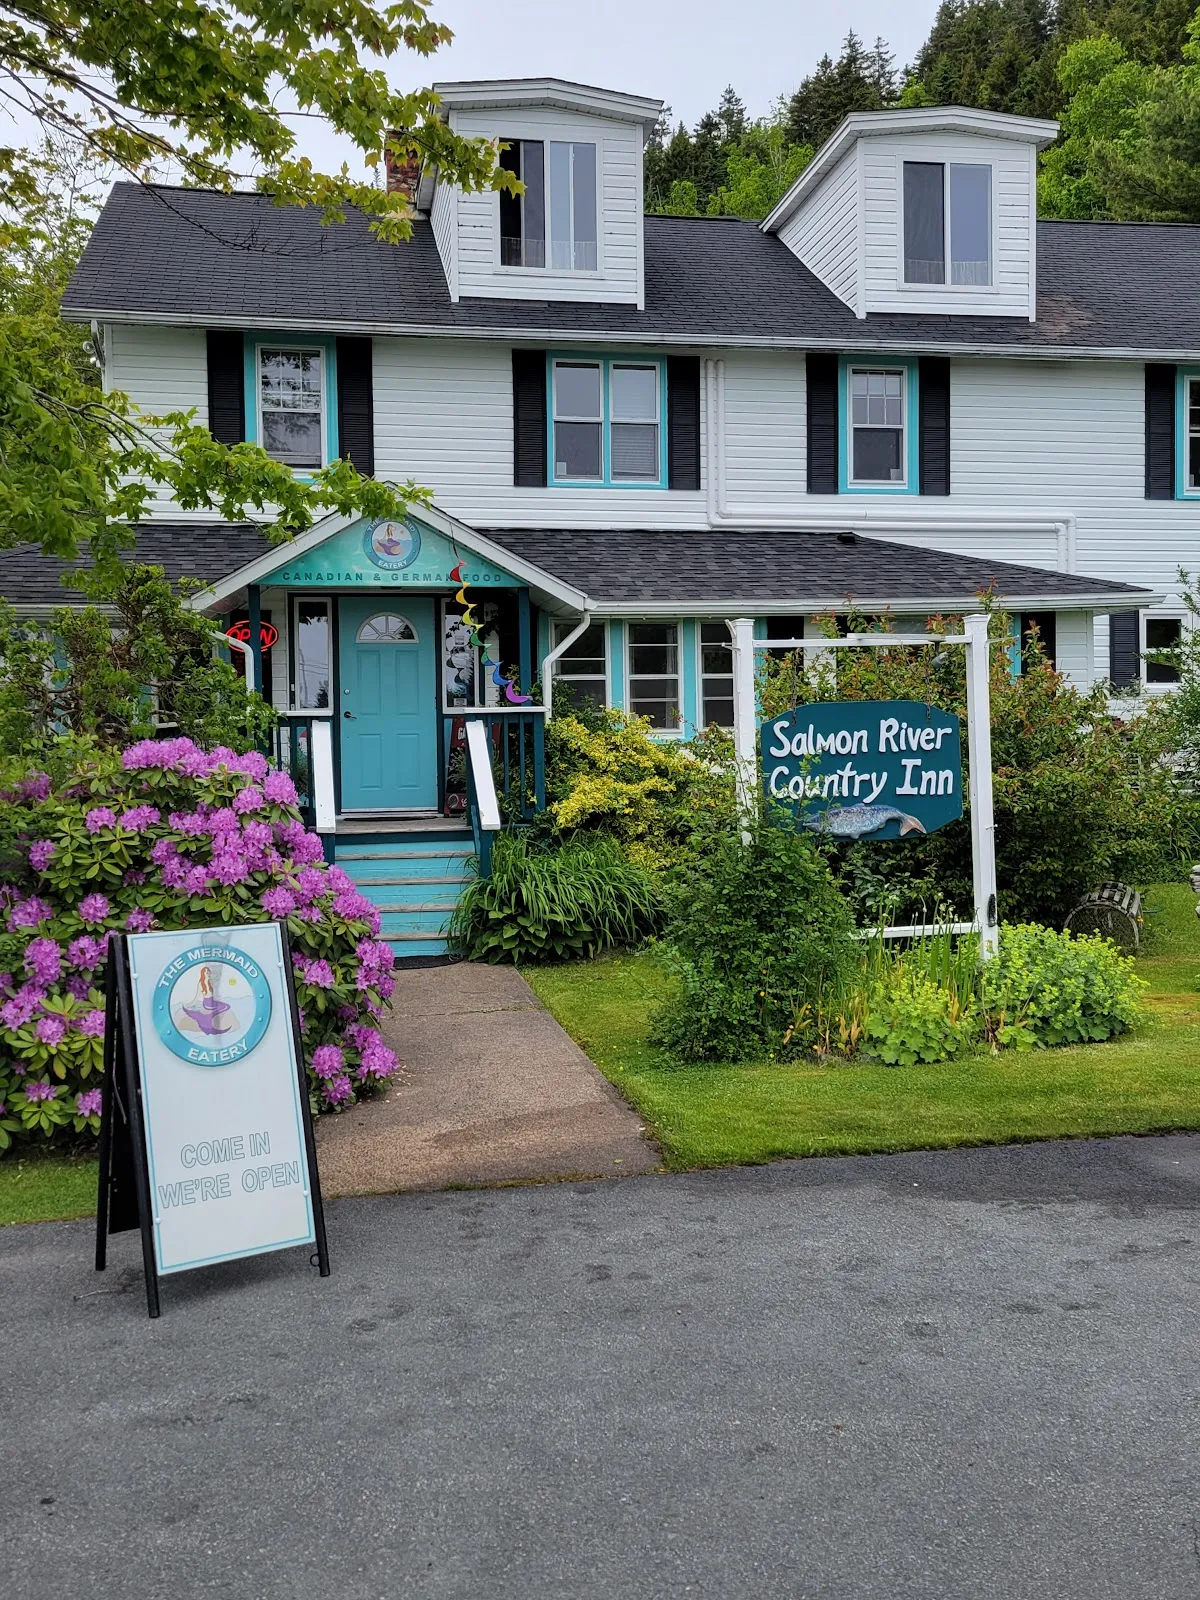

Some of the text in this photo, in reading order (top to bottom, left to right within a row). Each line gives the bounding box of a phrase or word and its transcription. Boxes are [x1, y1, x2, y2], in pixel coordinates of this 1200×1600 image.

[282, 572, 363, 581] CANADIAN
[373, 573, 381, 581] &
[463, 574, 501, 582] FOOD
[378, 560, 407, 569] EATERY
[229, 628, 273, 645] OPN
[770, 717, 953, 758] Salmon River
[896, 758, 954, 795] Inn
[158, 948, 259, 988] THE MERMAID
[187, 1038, 248, 1063] EATERY
[180, 1131, 271, 1168] COME IN
[158, 1161, 300, 1209] WE'RE OPEN
